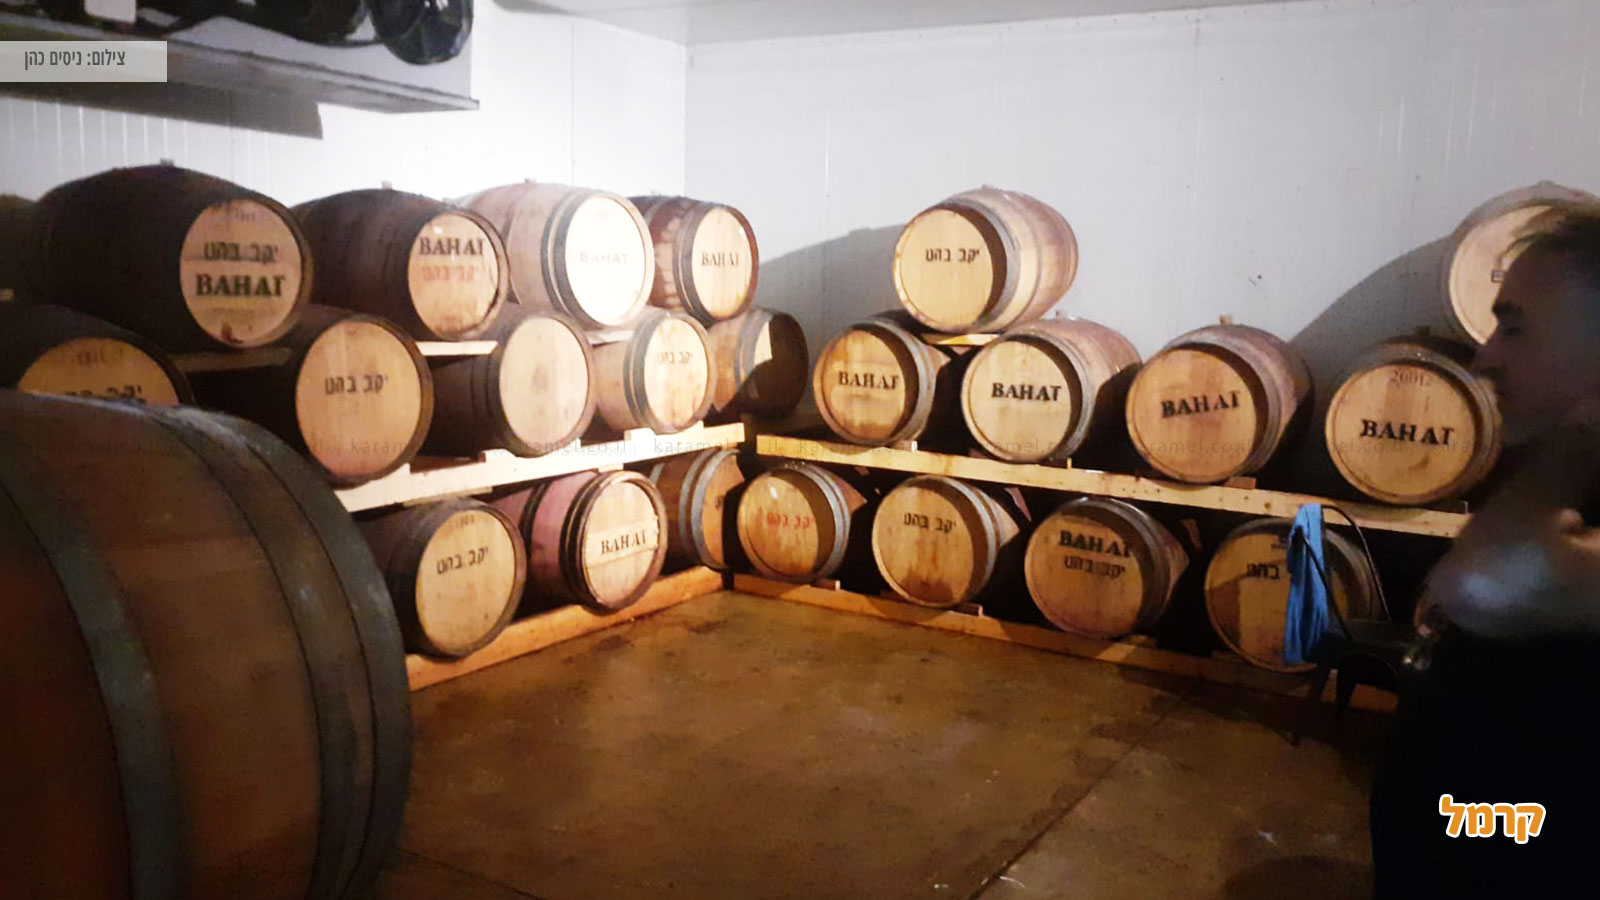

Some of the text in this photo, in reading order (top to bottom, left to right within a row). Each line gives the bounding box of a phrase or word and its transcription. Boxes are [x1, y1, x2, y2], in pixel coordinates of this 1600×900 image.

[419, 237, 485, 256] BAHAT
[925, 247, 981, 264] יקב בהט
[579, 250, 630, 265] BAHAT
[701, 252, 739, 267] BAHAT
[195, 273, 286, 297] BAHAT
[838, 370, 900, 391] BAHAT
[991, 382, 1062, 403] BAHAT
[1161, 390, 1240, 419] BAHAT
[1360, 418, 1456, 446] BAHAT
[903, 513, 957, 533] יקב בהט
[600, 529, 647, 555] BAHAT
[1059, 529, 1130, 557] BAHAT
[468, 547, 489, 567] יקב
